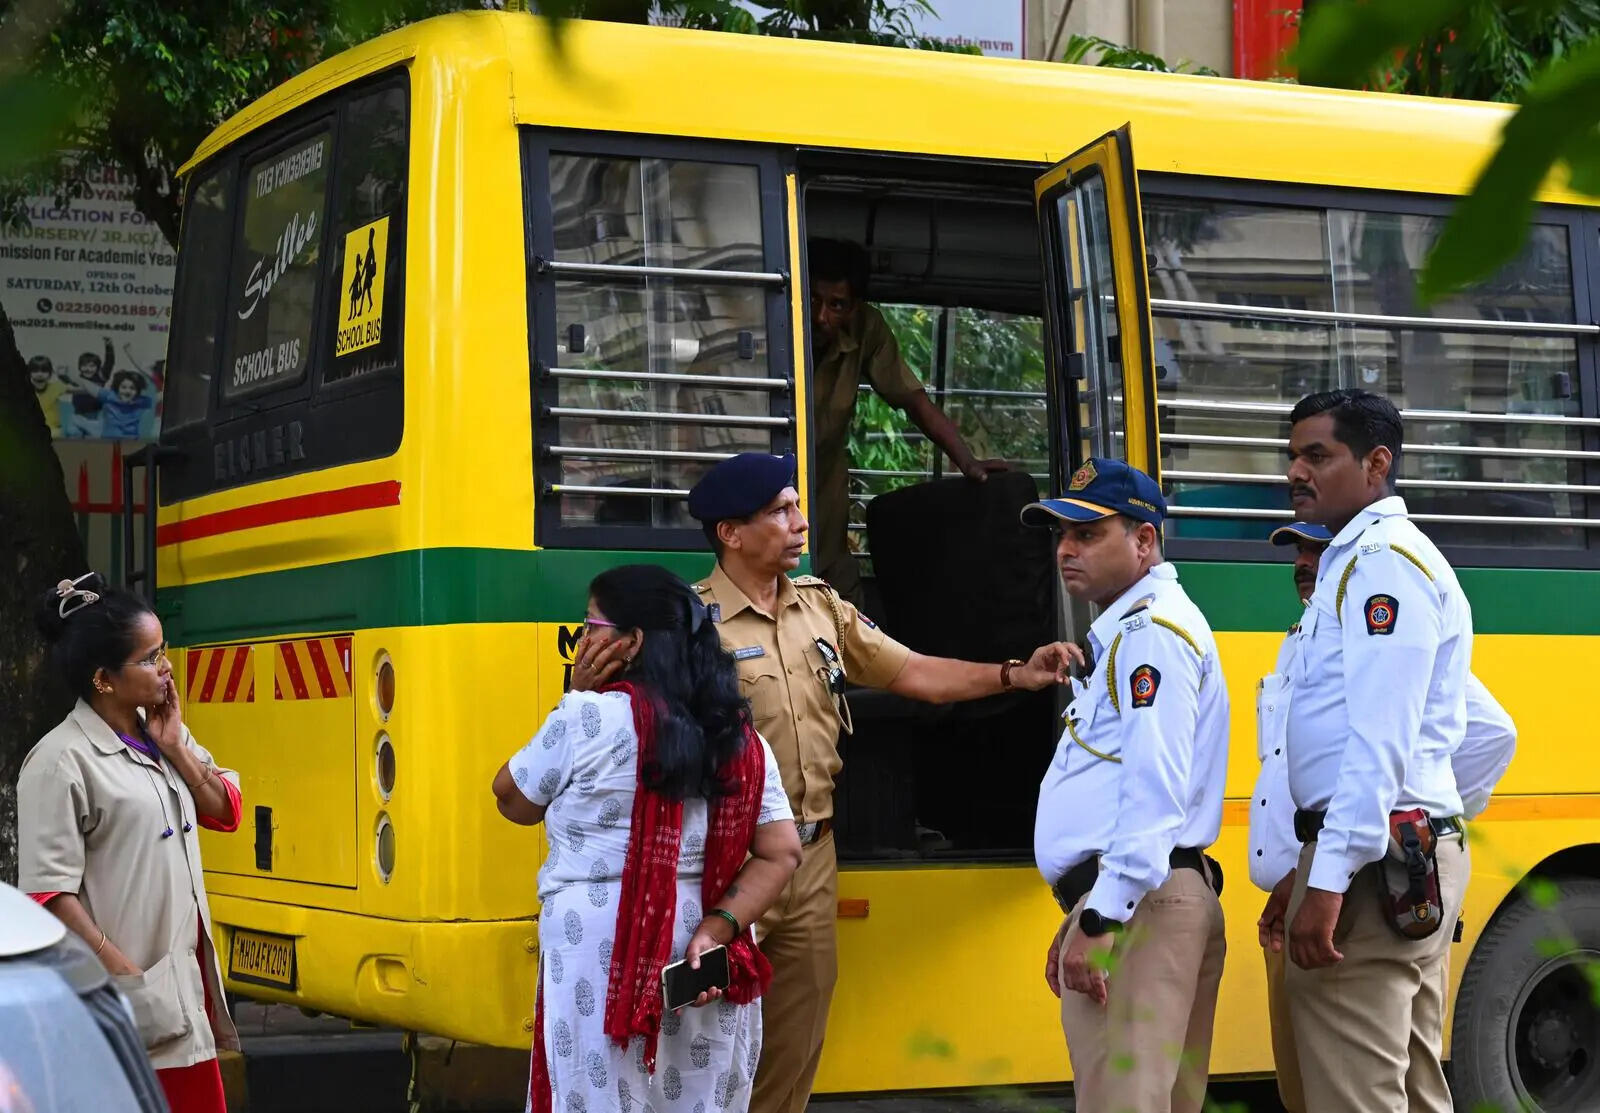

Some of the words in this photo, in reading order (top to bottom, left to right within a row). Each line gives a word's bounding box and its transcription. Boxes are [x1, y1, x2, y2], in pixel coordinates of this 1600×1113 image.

[54, 246, 75, 262] For
[78, 247, 146, 266] Academic
[6, 277, 85, 294] SATURDAY,
[89, 281, 120, 293] 12th
[86, 270, 119, 280] OPENS
[121, 272, 136, 281] ON
[336, 323, 364, 353] SCHOOL
[365, 318, 381, 344] BUS
[233, 346, 275, 387] SCHOOL
[276, 338, 300, 374] BUS
[238, 937, 292, 978] MH04FK2091
